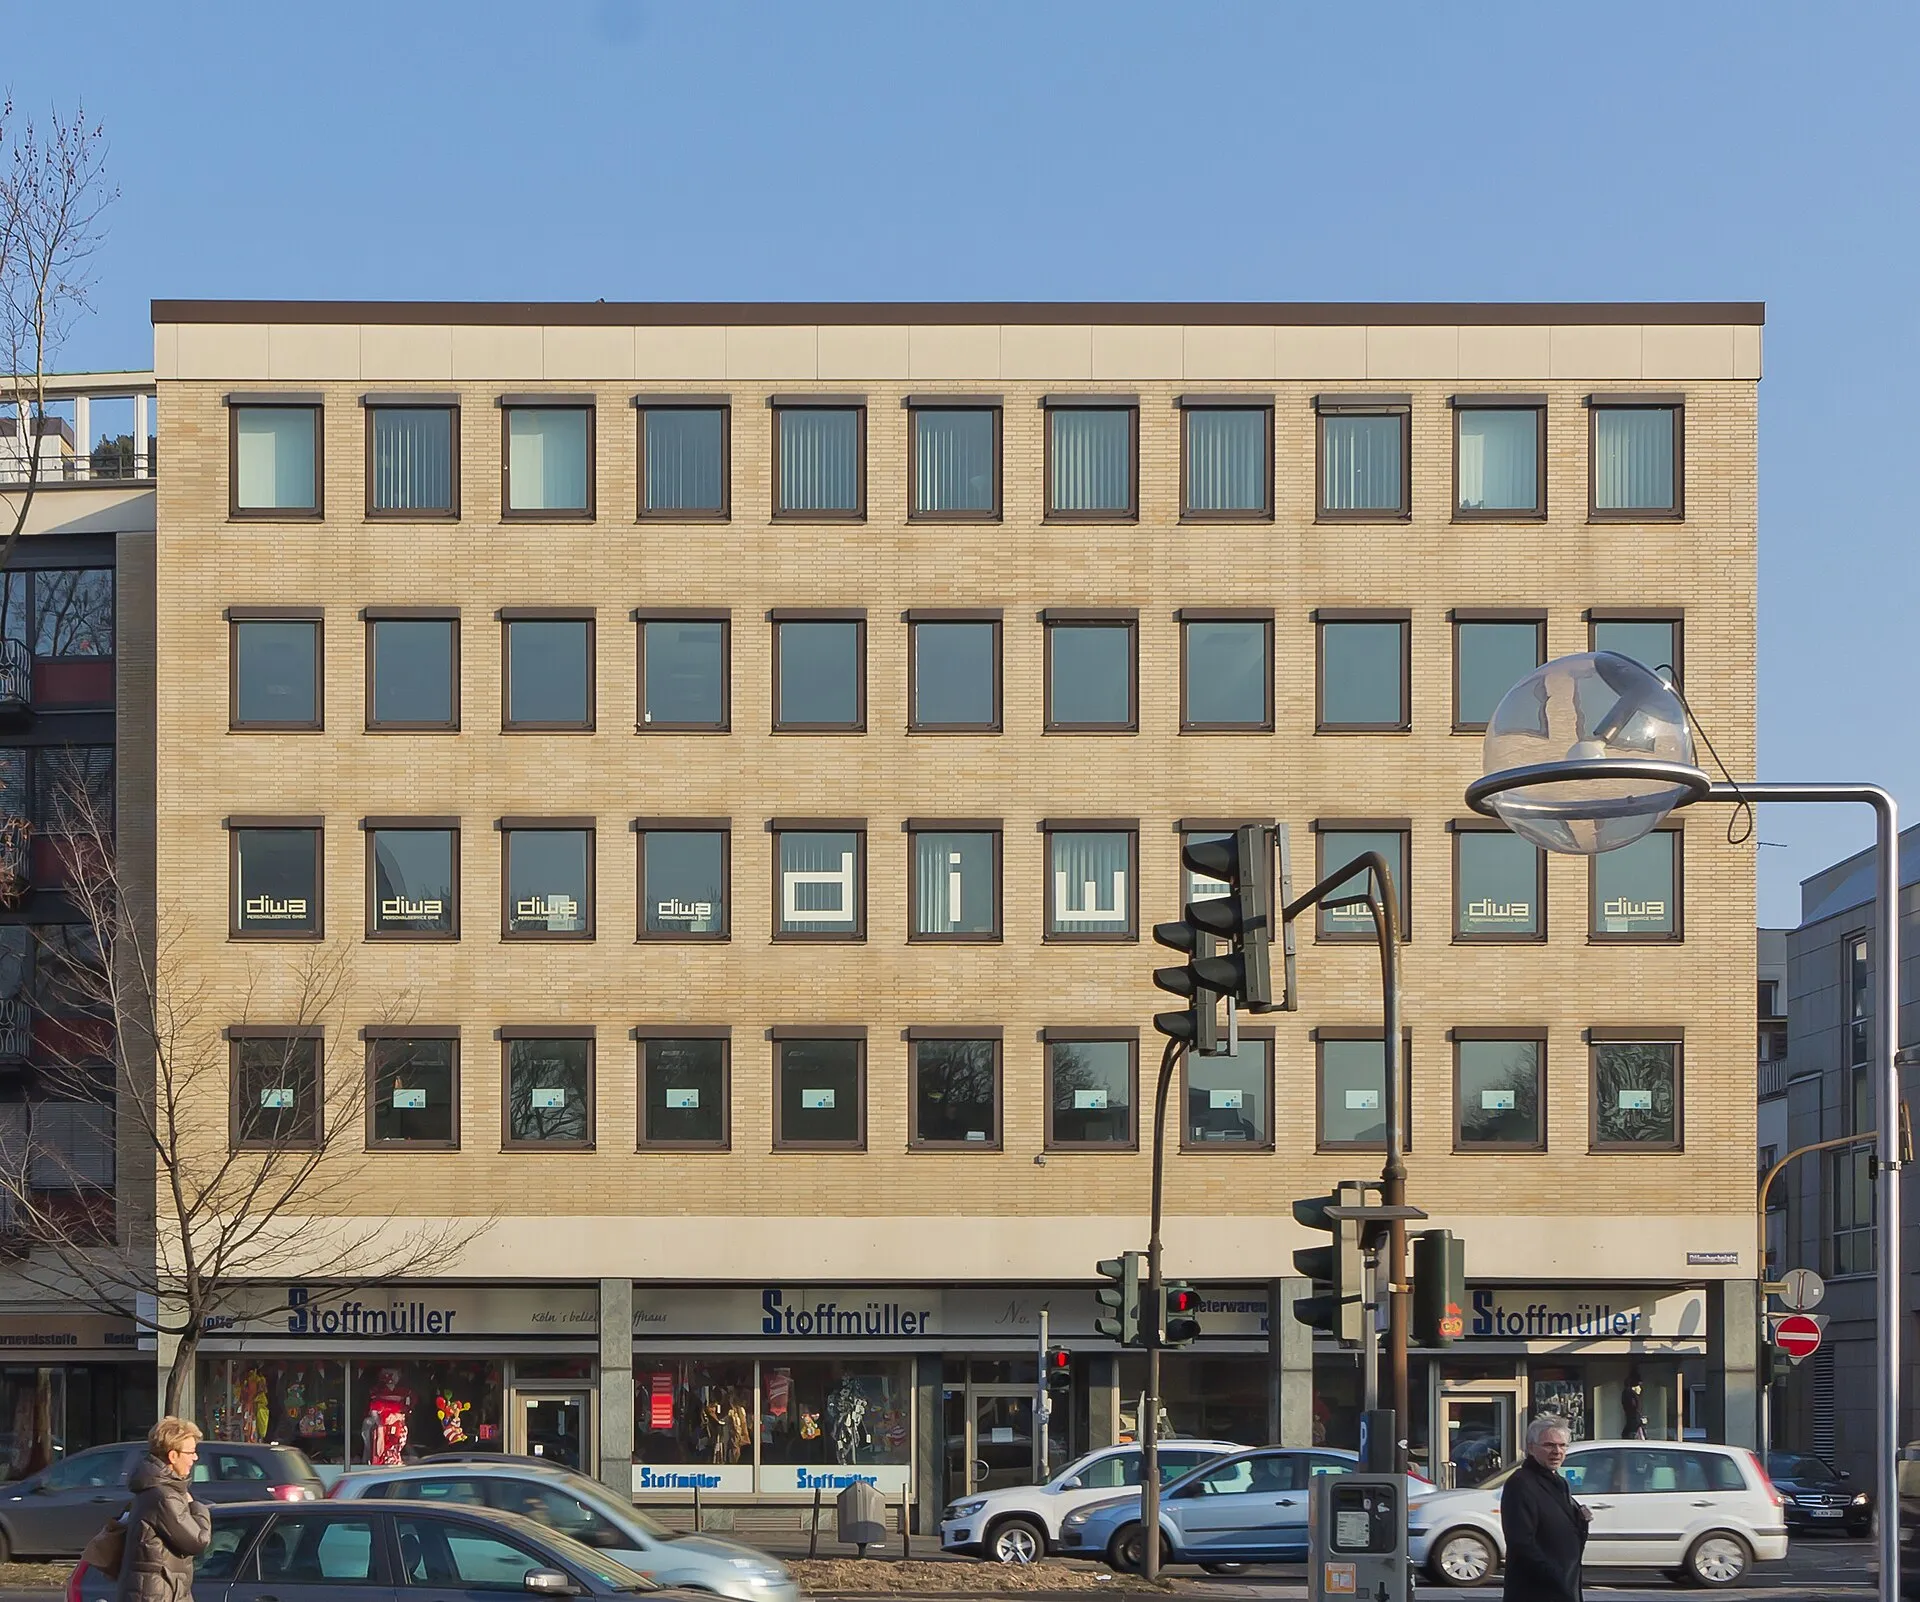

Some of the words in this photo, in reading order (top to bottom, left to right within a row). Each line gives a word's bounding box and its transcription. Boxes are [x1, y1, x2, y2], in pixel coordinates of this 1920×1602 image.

[246, 895, 307, 913] diwa
[381, 895, 442, 914] diwa
[517, 896, 577, 914] diwa
[658, 899, 711, 915] diwa
[1468, 898, 1529, 916] diwa
[1604, 897, 1665, 915] diwa
[288, 1288, 456, 1333] Stoffmüller
[762, 1289, 931, 1334] Stoffmüller
[1194, 1300, 1267, 1313] eterwaren
[1473, 1290, 1641, 1335] Stoffmüller
[641, 1467, 721, 1488] Stoffmüller
